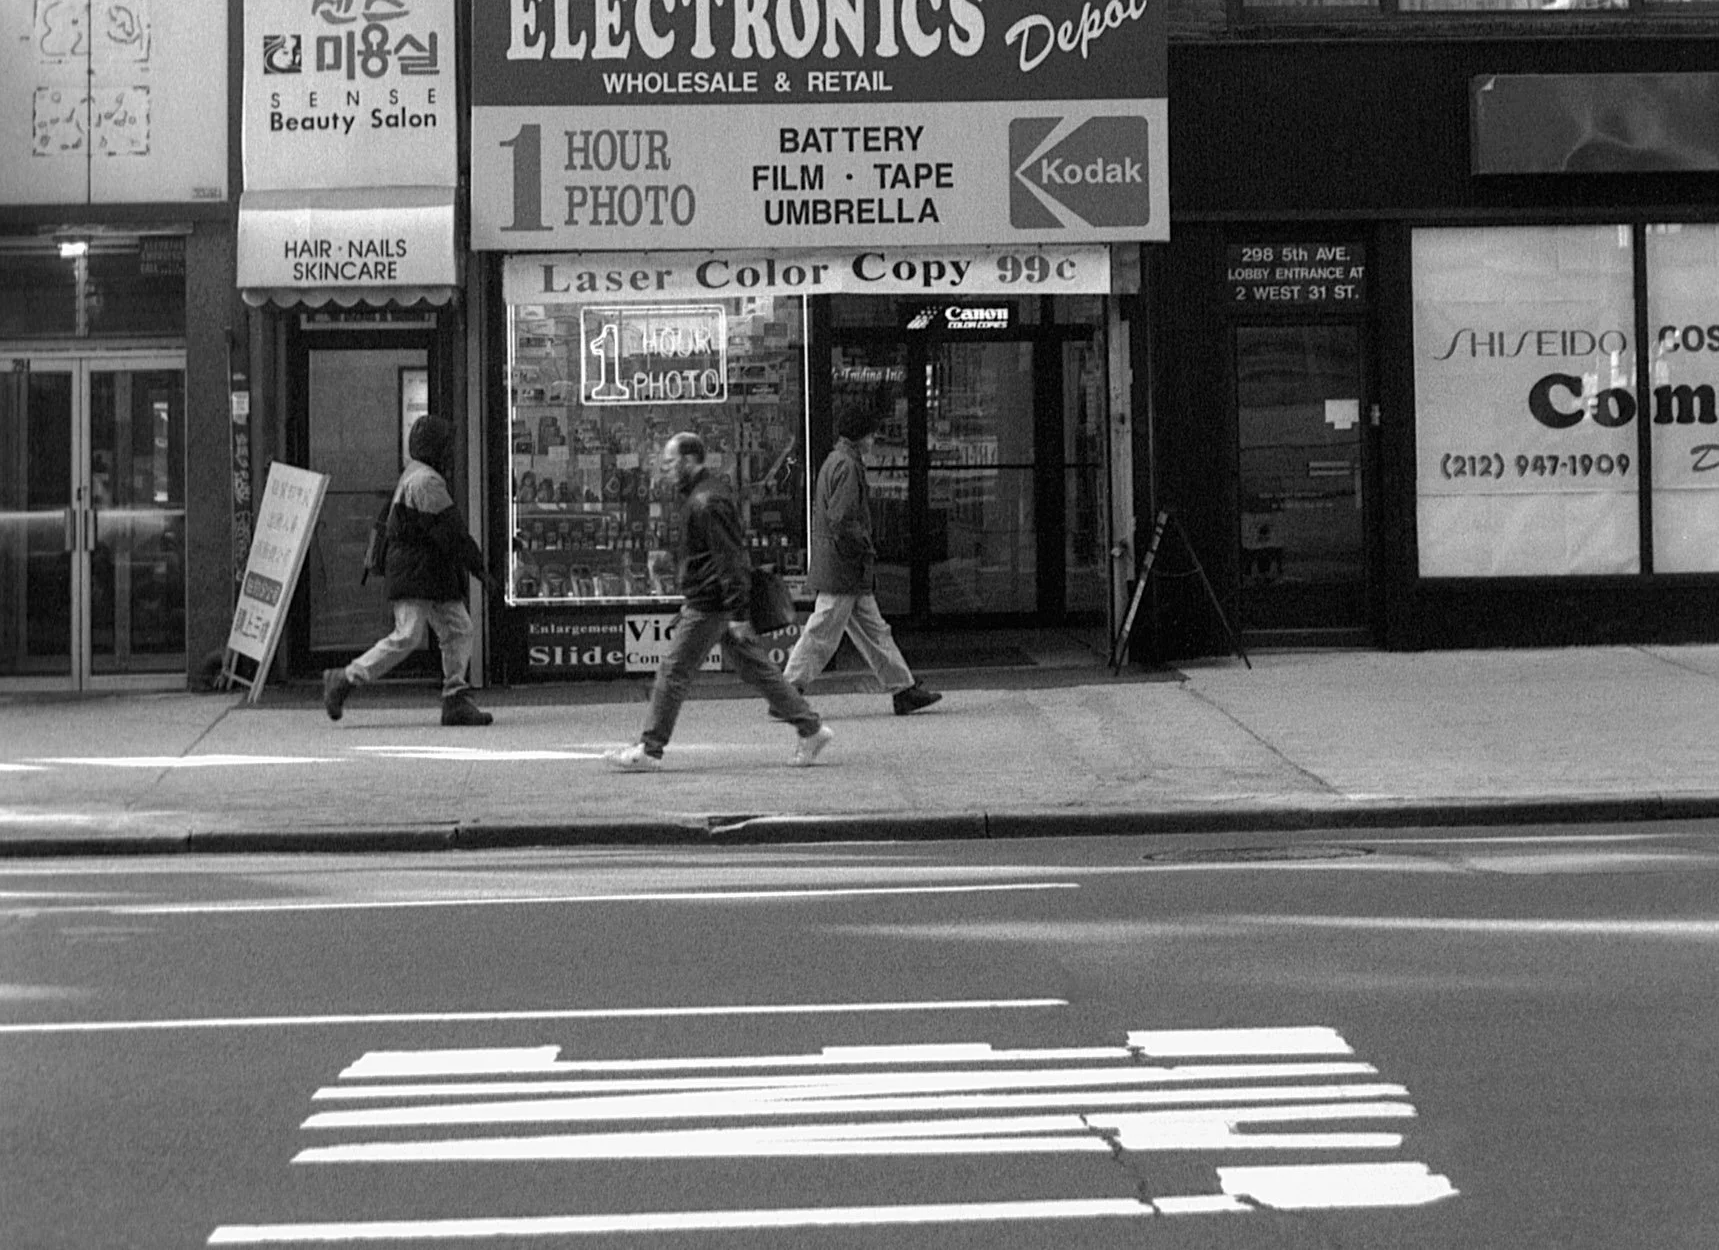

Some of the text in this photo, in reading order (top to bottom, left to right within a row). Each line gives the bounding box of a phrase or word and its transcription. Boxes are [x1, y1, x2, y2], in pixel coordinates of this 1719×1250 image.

[316, 22, 440, 80] 미용실
[602, 70, 893, 94] WHOLESALE & RETAIL
[271, 89, 437, 108] SENSE
[270, 108, 437, 135] Beauty Salon
[564, 129, 671, 171] HOUR
[779, 126, 925, 154] BATTERY
[499, 123, 554, 231] 1
[752, 163, 954, 191] FILM TAPE
[1041, 157, 1143, 185] Kodak
[564, 185, 696, 227] PHOTO
[764, 199, 940, 227] UMBRELLA
[284, 239, 407, 259] HAIR NAILS
[1242, 246, 1351, 262] 298 5th AVE.
[293, 261, 398, 281] SKINCARE
[540, 262, 673, 294] Laser
[695, 256, 829, 290] Color
[852, 251, 973, 291] Copy
[1228, 266, 1365, 281] LOBBY ENTRANCE AT
[1236, 285, 1359, 300] 2 WEST 31 ST.
[944, 306, 1009, 320] Canon
[642, 327, 712, 357] HOUR
[1433, 328, 1628, 360] SHISEIDO
[590, 324, 629, 400] 1
[634, 368, 720, 400] PHOTO
[1440, 453, 1631, 480] (212) 947-1909
[529, 623, 624, 636] Enlargement
[529, 645, 624, 666] Slide
